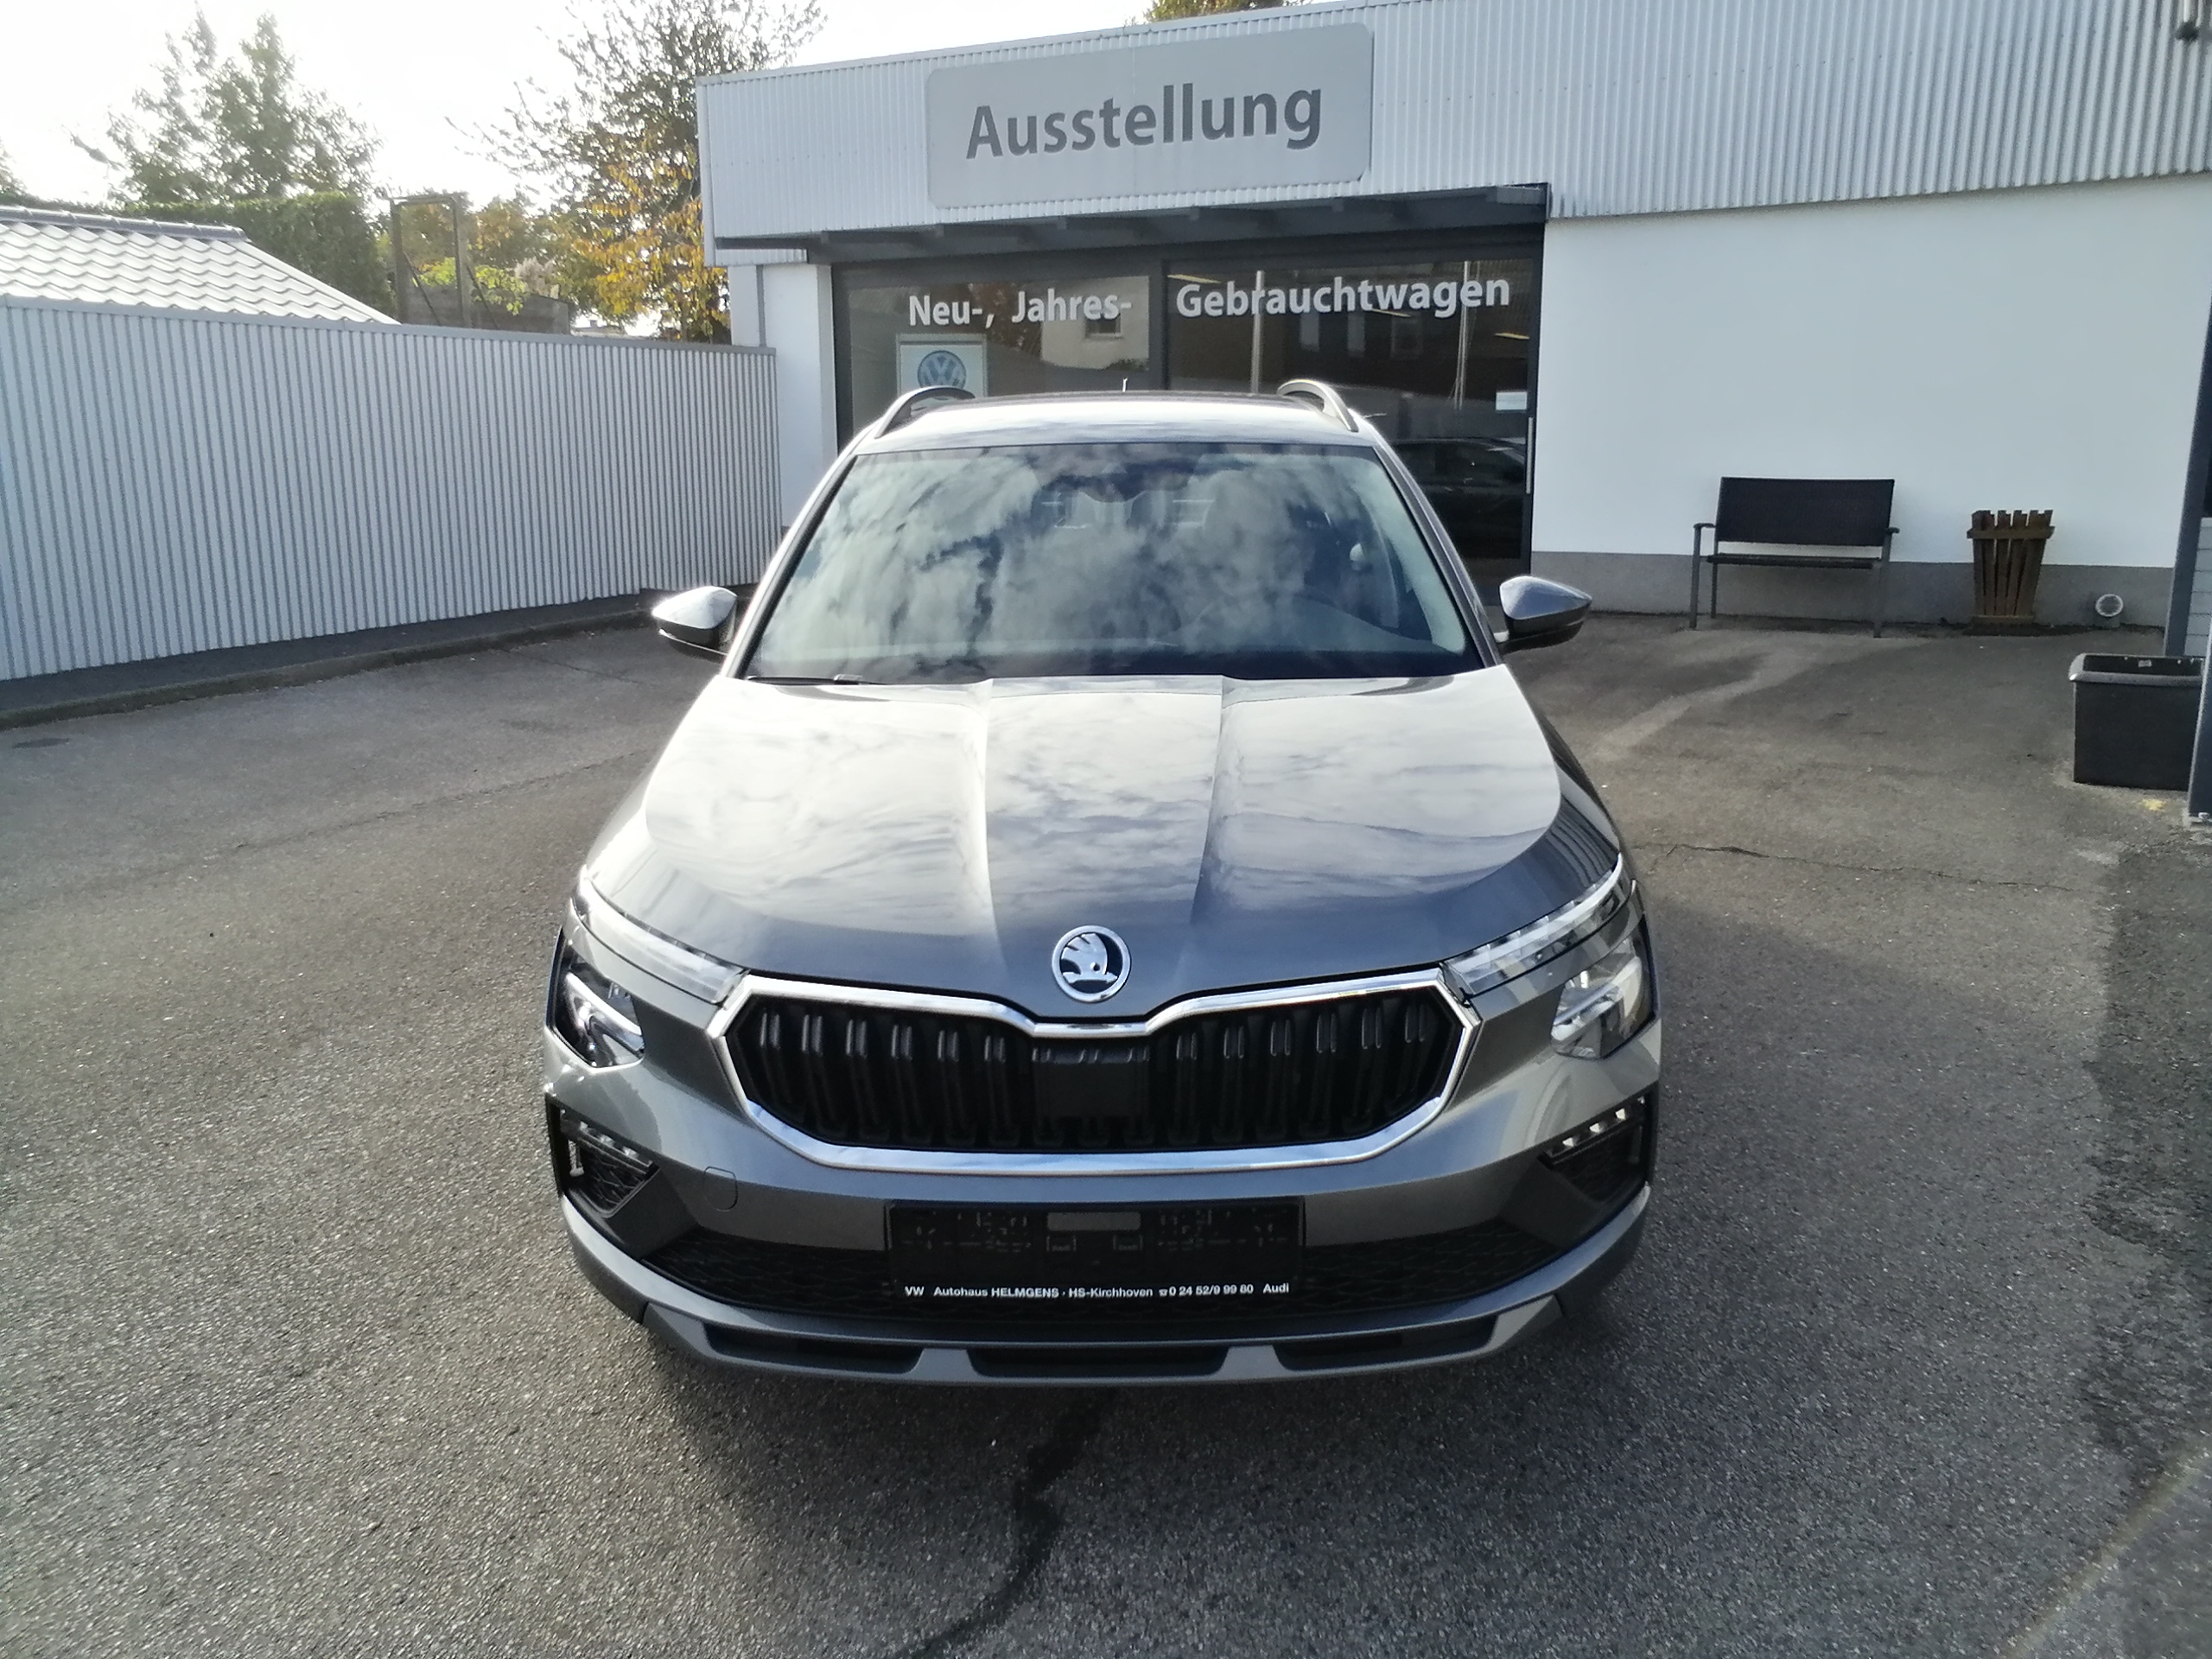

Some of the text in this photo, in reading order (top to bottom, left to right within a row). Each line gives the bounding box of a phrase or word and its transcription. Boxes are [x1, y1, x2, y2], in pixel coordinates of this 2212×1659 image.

[966, 83, 1322, 160] Ausstellung
[909, 276, 1510, 328] Neu-, Jahres- Gebrauchtwagen
[904, 1286, 925, 1297] VW
[933, 1286, 988, 1297] Autohaus
[991, 1287, 1059, 1299] HELMGENS
[1068, 1287, 1154, 1299] HS-Kirchhoven
[1179, 1285, 1193, 1297] 24
[1262, 1282, 1290, 1294] Audi
